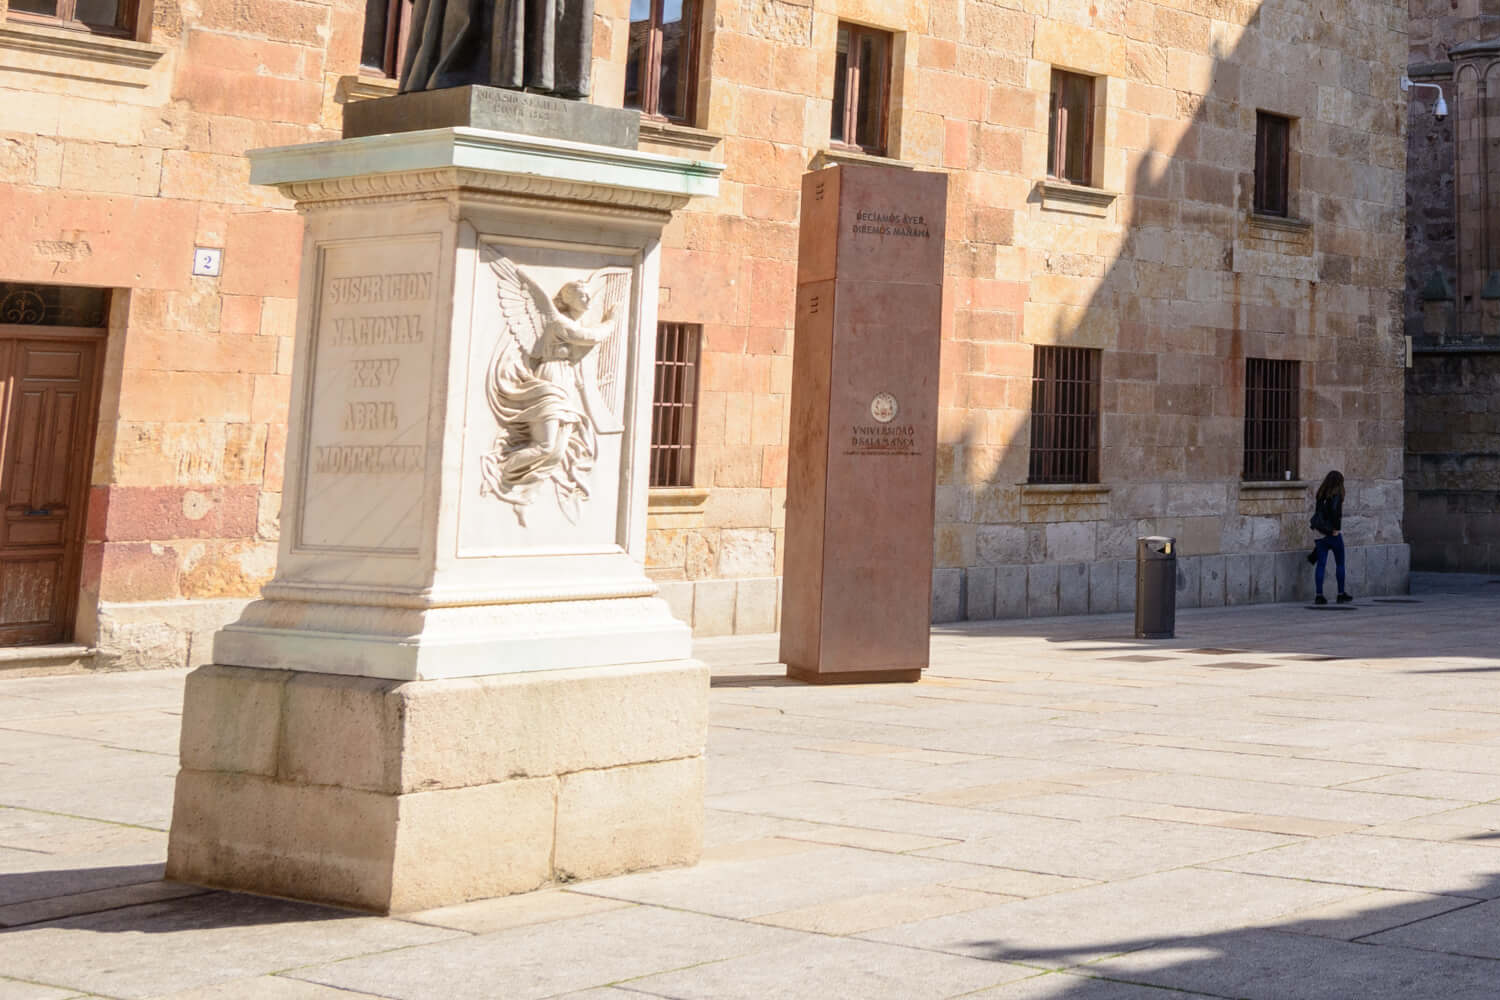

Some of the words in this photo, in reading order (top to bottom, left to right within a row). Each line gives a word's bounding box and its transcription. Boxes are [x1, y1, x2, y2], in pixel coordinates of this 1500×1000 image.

[203, 255, 212, 269] 2
[331, 315, 424, 345] NACIONAL
[350, 358, 400, 388] XXV
[344, 400, 399, 431] ABRIL
